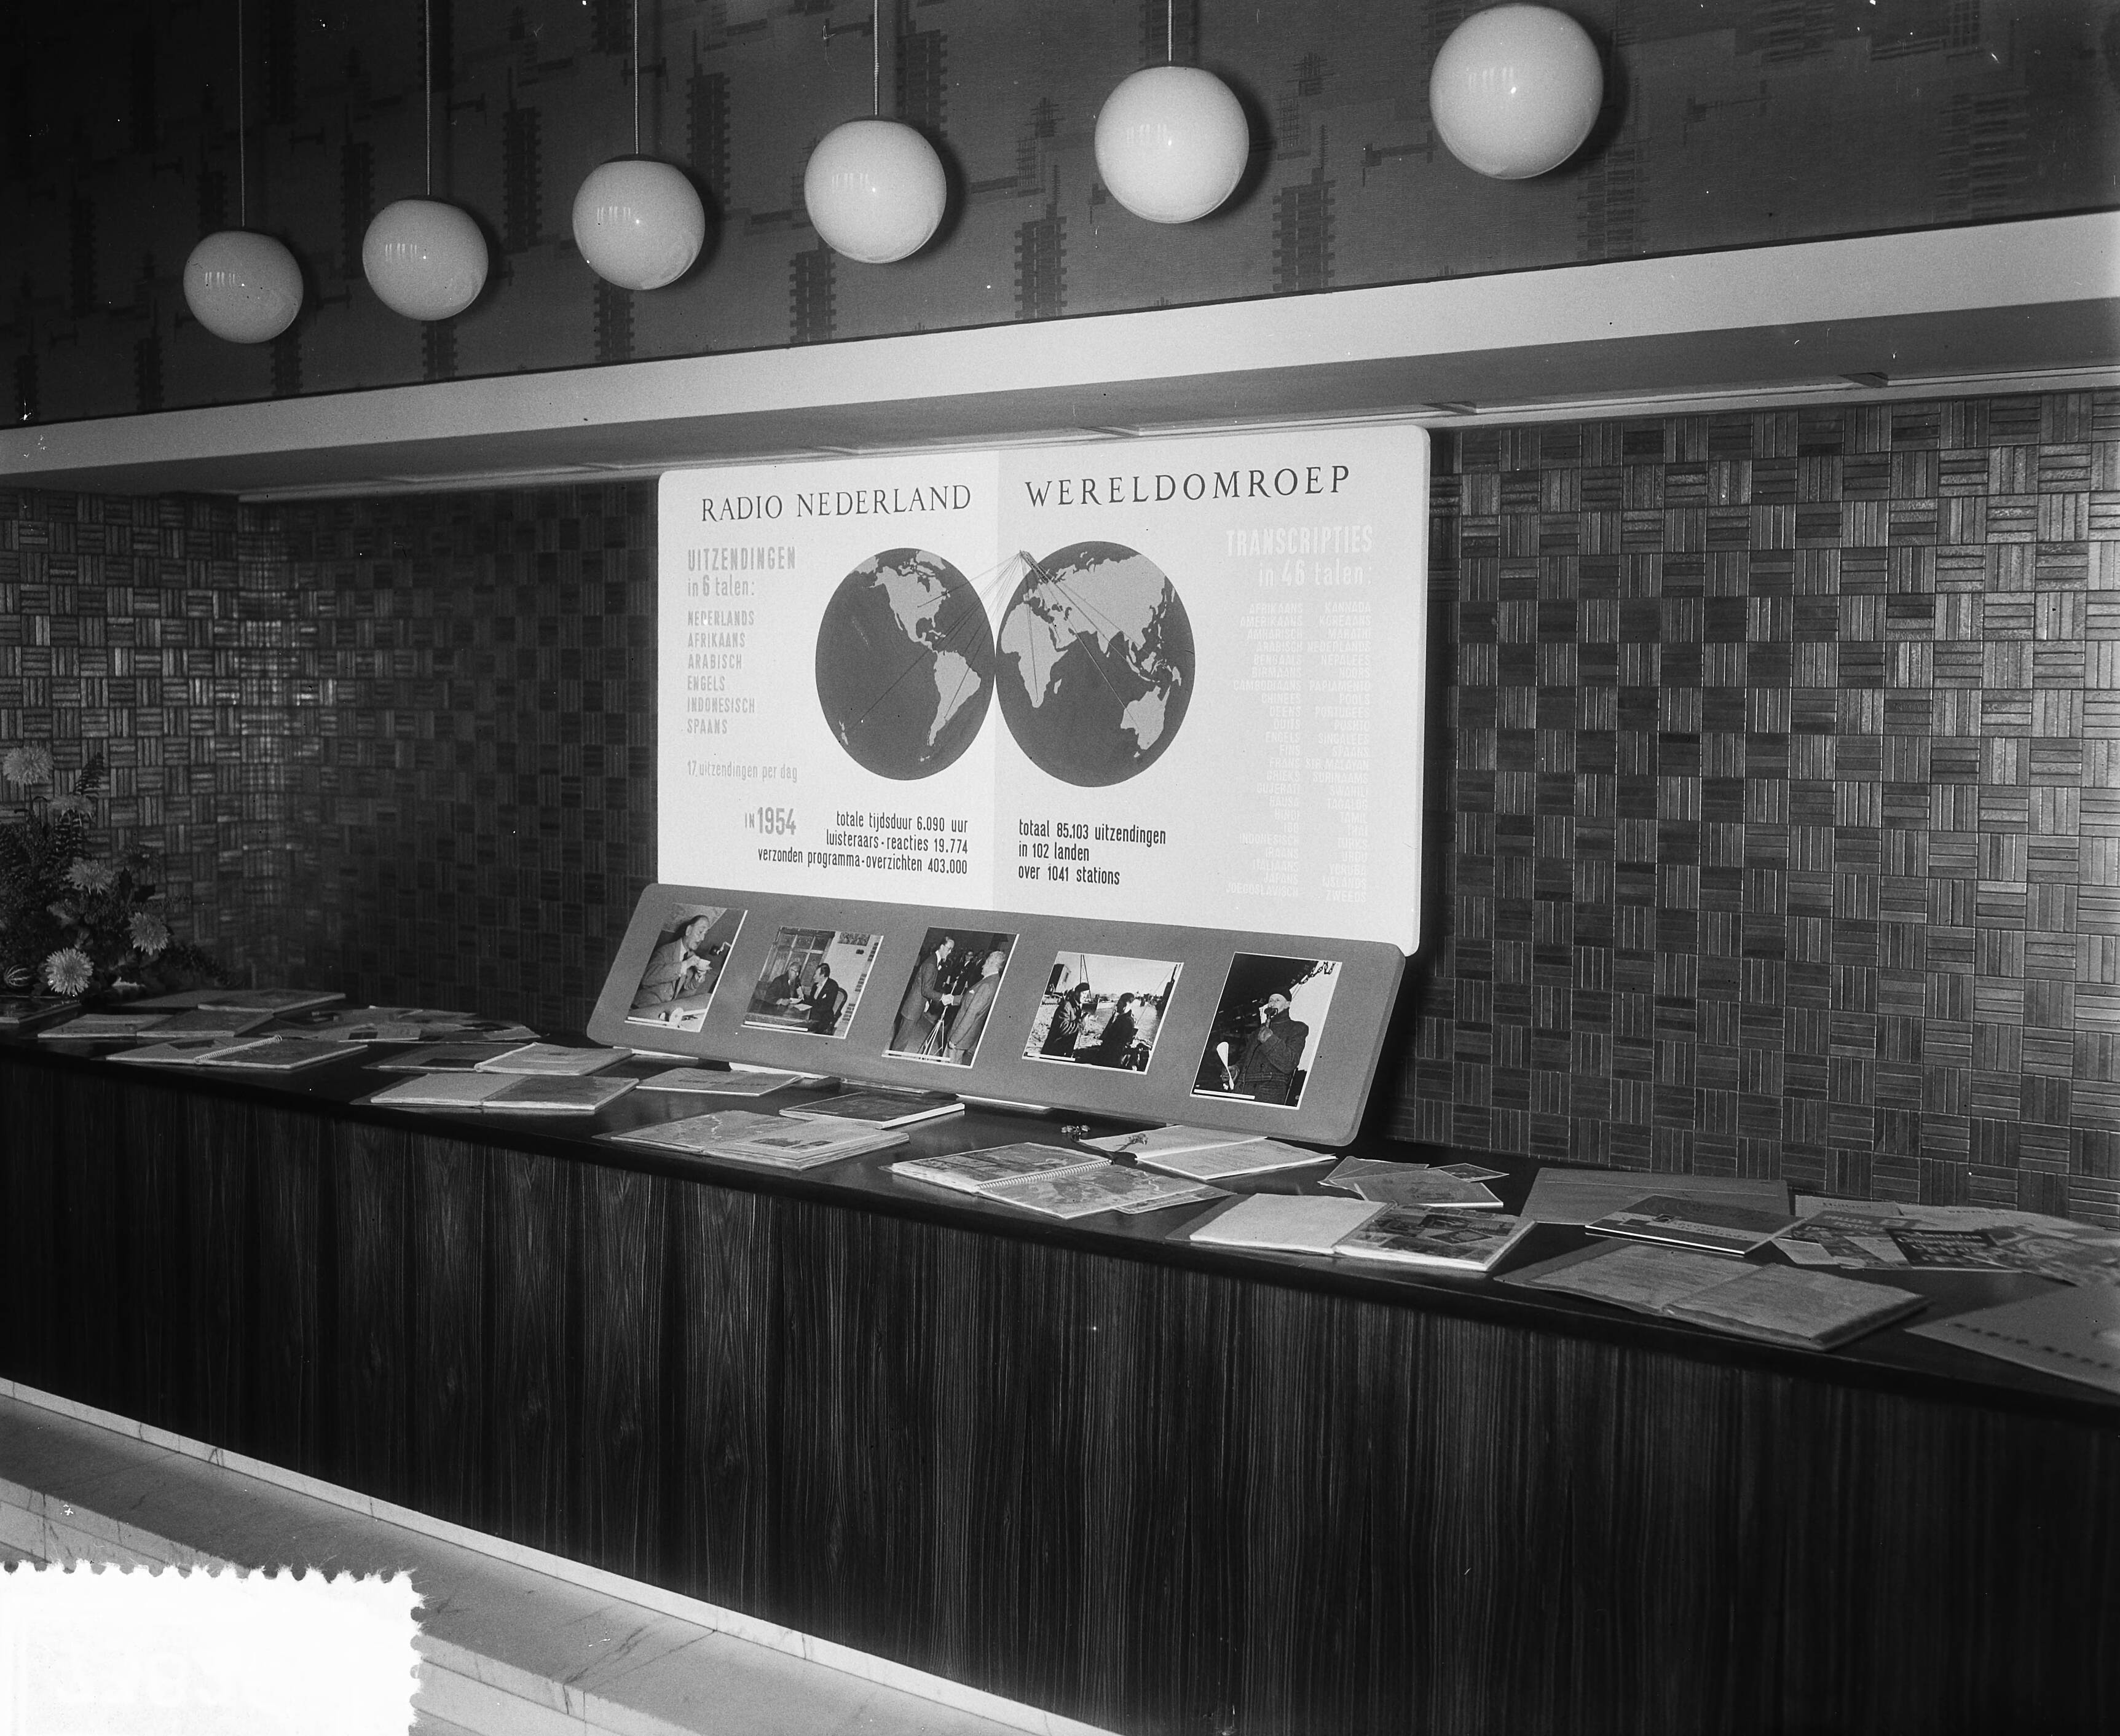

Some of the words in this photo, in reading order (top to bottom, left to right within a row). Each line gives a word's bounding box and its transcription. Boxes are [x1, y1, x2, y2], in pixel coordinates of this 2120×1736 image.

[703, 495, 782, 522] RADIO
[797, 485, 970, 517] NEDERLAND
[1025, 466, 1349, 506] WERELDOMROEP
[1226, 525, 1373, 557] TRANSCRIPTIES
[688, 546, 795, 571] UITZENDINGEN
[1259, 562, 1274, 587] in
[1280, 559, 1306, 586] 46
[1315, 558, 1372, 586] talen:
[688, 578, 698, 597] in
[703, 575, 709, 597] 6
[715, 574, 754, 596] talen:
[1250, 602, 1303, 614] AFRIKAANS
[1325, 601, 1371, 613] KANNADA
[688, 610, 754, 626] NEDERLANDS
[1240, 615, 1303, 627] AMERIKAANS
[1319, 615, 1371, 627] KOREAANS
[688, 632, 745, 648] AFRIKAANS
[1247, 628, 1303, 640] AMHARISCH
[1328, 627, 1371, 640] MARATHI
[1256, 640, 1303, 653] ARABISCH
[1307, 640, 1371, 653] NEDERLANDS
[688, 653, 741, 669] ARABISCH
[1254, 654, 1302, 666] BENGAALS
[1321, 653, 1371, 666] NEPALEES
[1251, 666, 1302, 678] BIRMAANS
[1339, 667, 1371, 678] NOORS
[687, 675, 725, 691] ENGELS
[1233, 680, 1302, 691] CAMBODIAANS
[1309, 680, 1371, 692] PAPIAMENTO
[687, 697, 754, 713] INDONESISCH
[1261, 693, 1301, 704] CHINEES
[1339, 693, 1371, 705] POOLS
[1269, 705, 1301, 717] DEENS
[1315, 705, 1370, 718] PORTUGEES
[687, 718, 727, 734] SPAANS
[1274, 718, 1301, 730] DUITS
[1265, 731, 1301, 743] ENGELS
[1318, 732, 1370, 745] SINGALEES
[1279, 744, 1301, 756] FINS
[1332, 745, 1369, 758] SPAANS
[1269, 756, 1301, 769] FRANS
[699, 761, 757, 780] uitzendingen
[762, 766, 777, 782] per
[781, 764, 797, 783] dag
[1266, 770, 1301, 782] GRIEKS
[1312, 771, 1369, 784] SURINAAMS
[1256, 782, 1300, 795] GUJERATI
[1269, 795, 1299, 807] HAUSA
[1327, 798, 1368, 811] TAGALOG
[745, 812, 755, 828] IN
[757, 807, 796, 836] 1954
[837, 811, 864, 827] totale
[869, 812, 912, 832] tijdsduur
[917, 816, 944, 831] 6.090
[952, 820, 967, 833] uur
[1339, 811, 1368, 823] TAMIL
[1019, 819, 1049, 837] totaal
[1057, 822, 1089, 839] 85.103
[1095, 823, 1165, 847] uitzendingen
[1347, 824, 1368, 837] THAI
[934, 838, 967, 854] 19.774
[1240, 833, 1299, 846] INDONESISCH
[1019, 841, 1027, 857] in
[1033, 843, 1049, 858] 102
[1054, 842, 1089, 861] landen
[1266, 847, 1299, 859] IRAANS
[1342, 850, 1368, 863] URDU
[759, 847, 803, 863] verzonden
[928, 858, 967, 874] 403.000
[1252, 858, 1299, 873] ITALIAANS
[1019, 866, 1040, 879] over
[1048, 866, 1068, 881] 1041
[1076, 866, 1120, 885] stations
[1329, 863, 1366, 876] YORUBA
[1263, 872, 1299, 885] JAPANS
[1326, 890, 1366, 903] ZWEEDS
